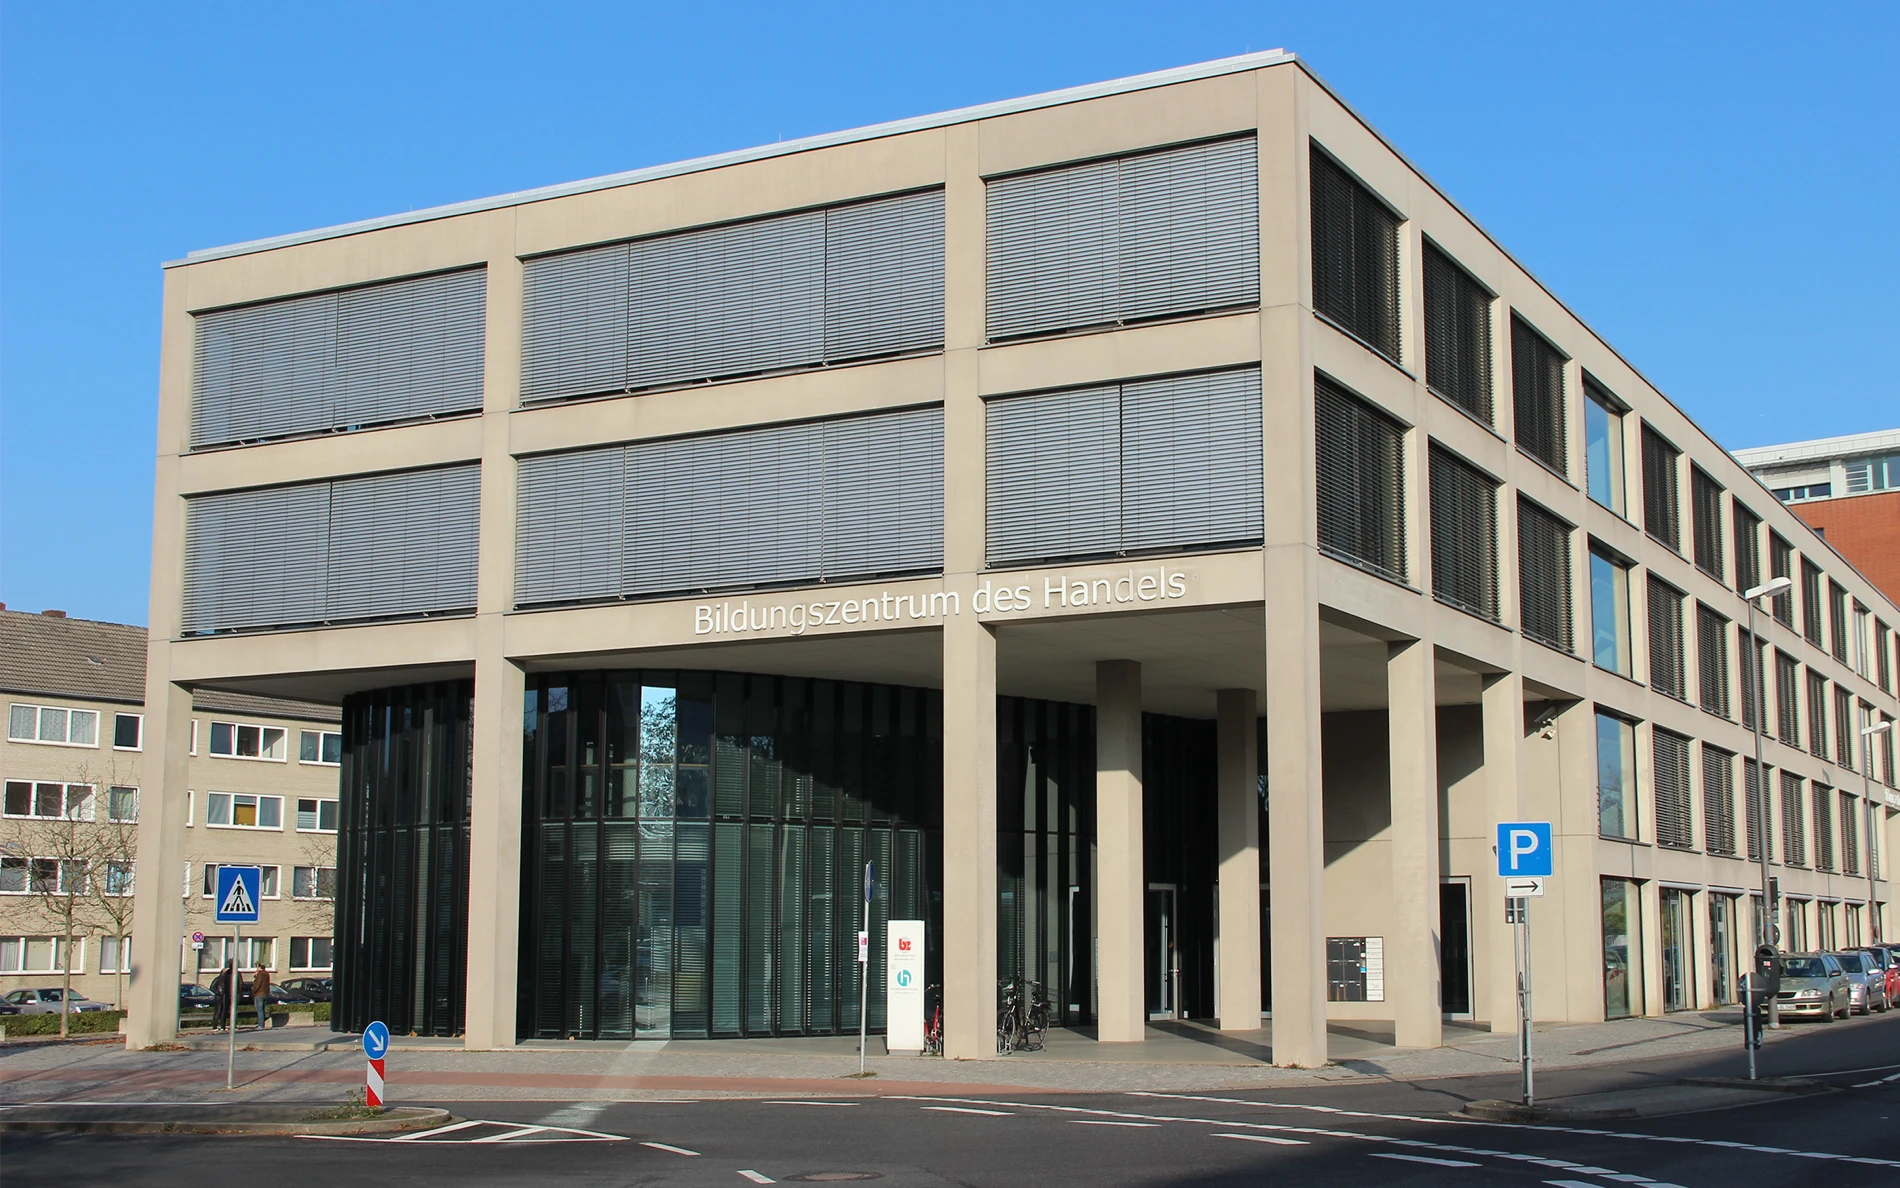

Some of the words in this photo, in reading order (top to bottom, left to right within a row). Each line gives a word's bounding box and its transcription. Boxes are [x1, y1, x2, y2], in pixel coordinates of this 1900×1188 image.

[694, 590, 960, 636] Bildungszentrum
[972, 580, 1032, 614] des
[1044, 566, 1187, 609] Handels
[1509, 829, 1539, 870] P
[898, 938, 911, 951] bz
